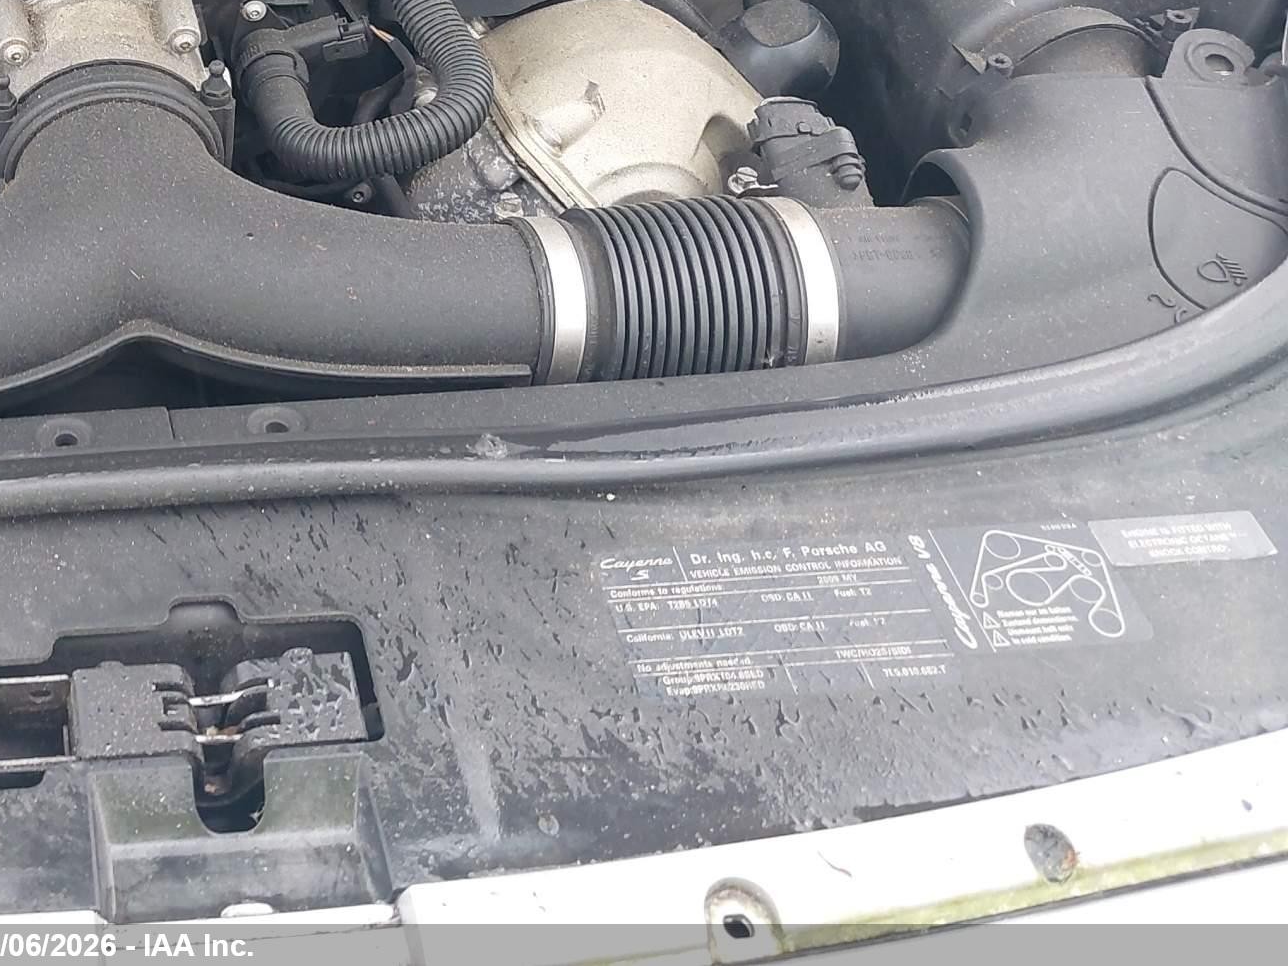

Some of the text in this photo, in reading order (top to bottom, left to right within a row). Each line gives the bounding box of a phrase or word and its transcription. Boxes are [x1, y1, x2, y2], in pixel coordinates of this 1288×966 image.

[689, 553, 711, 565] Dr.
[716, 550, 745, 564] Ing.
[782, 546, 795, 560] F.
[800, 543, 858, 557] Porsche
[864, 540, 887, 553] AG
[600, 557, 674, 573] Cayenne
[689, 556, 903, 580] VEHICLE EMISSION CONTROL INFORMATION
[610, 587, 655, 599] Conforms
[657, 586, 668, 596] to
[636, 664, 652, 673] No
[656, 660, 714, 673] adjustments
